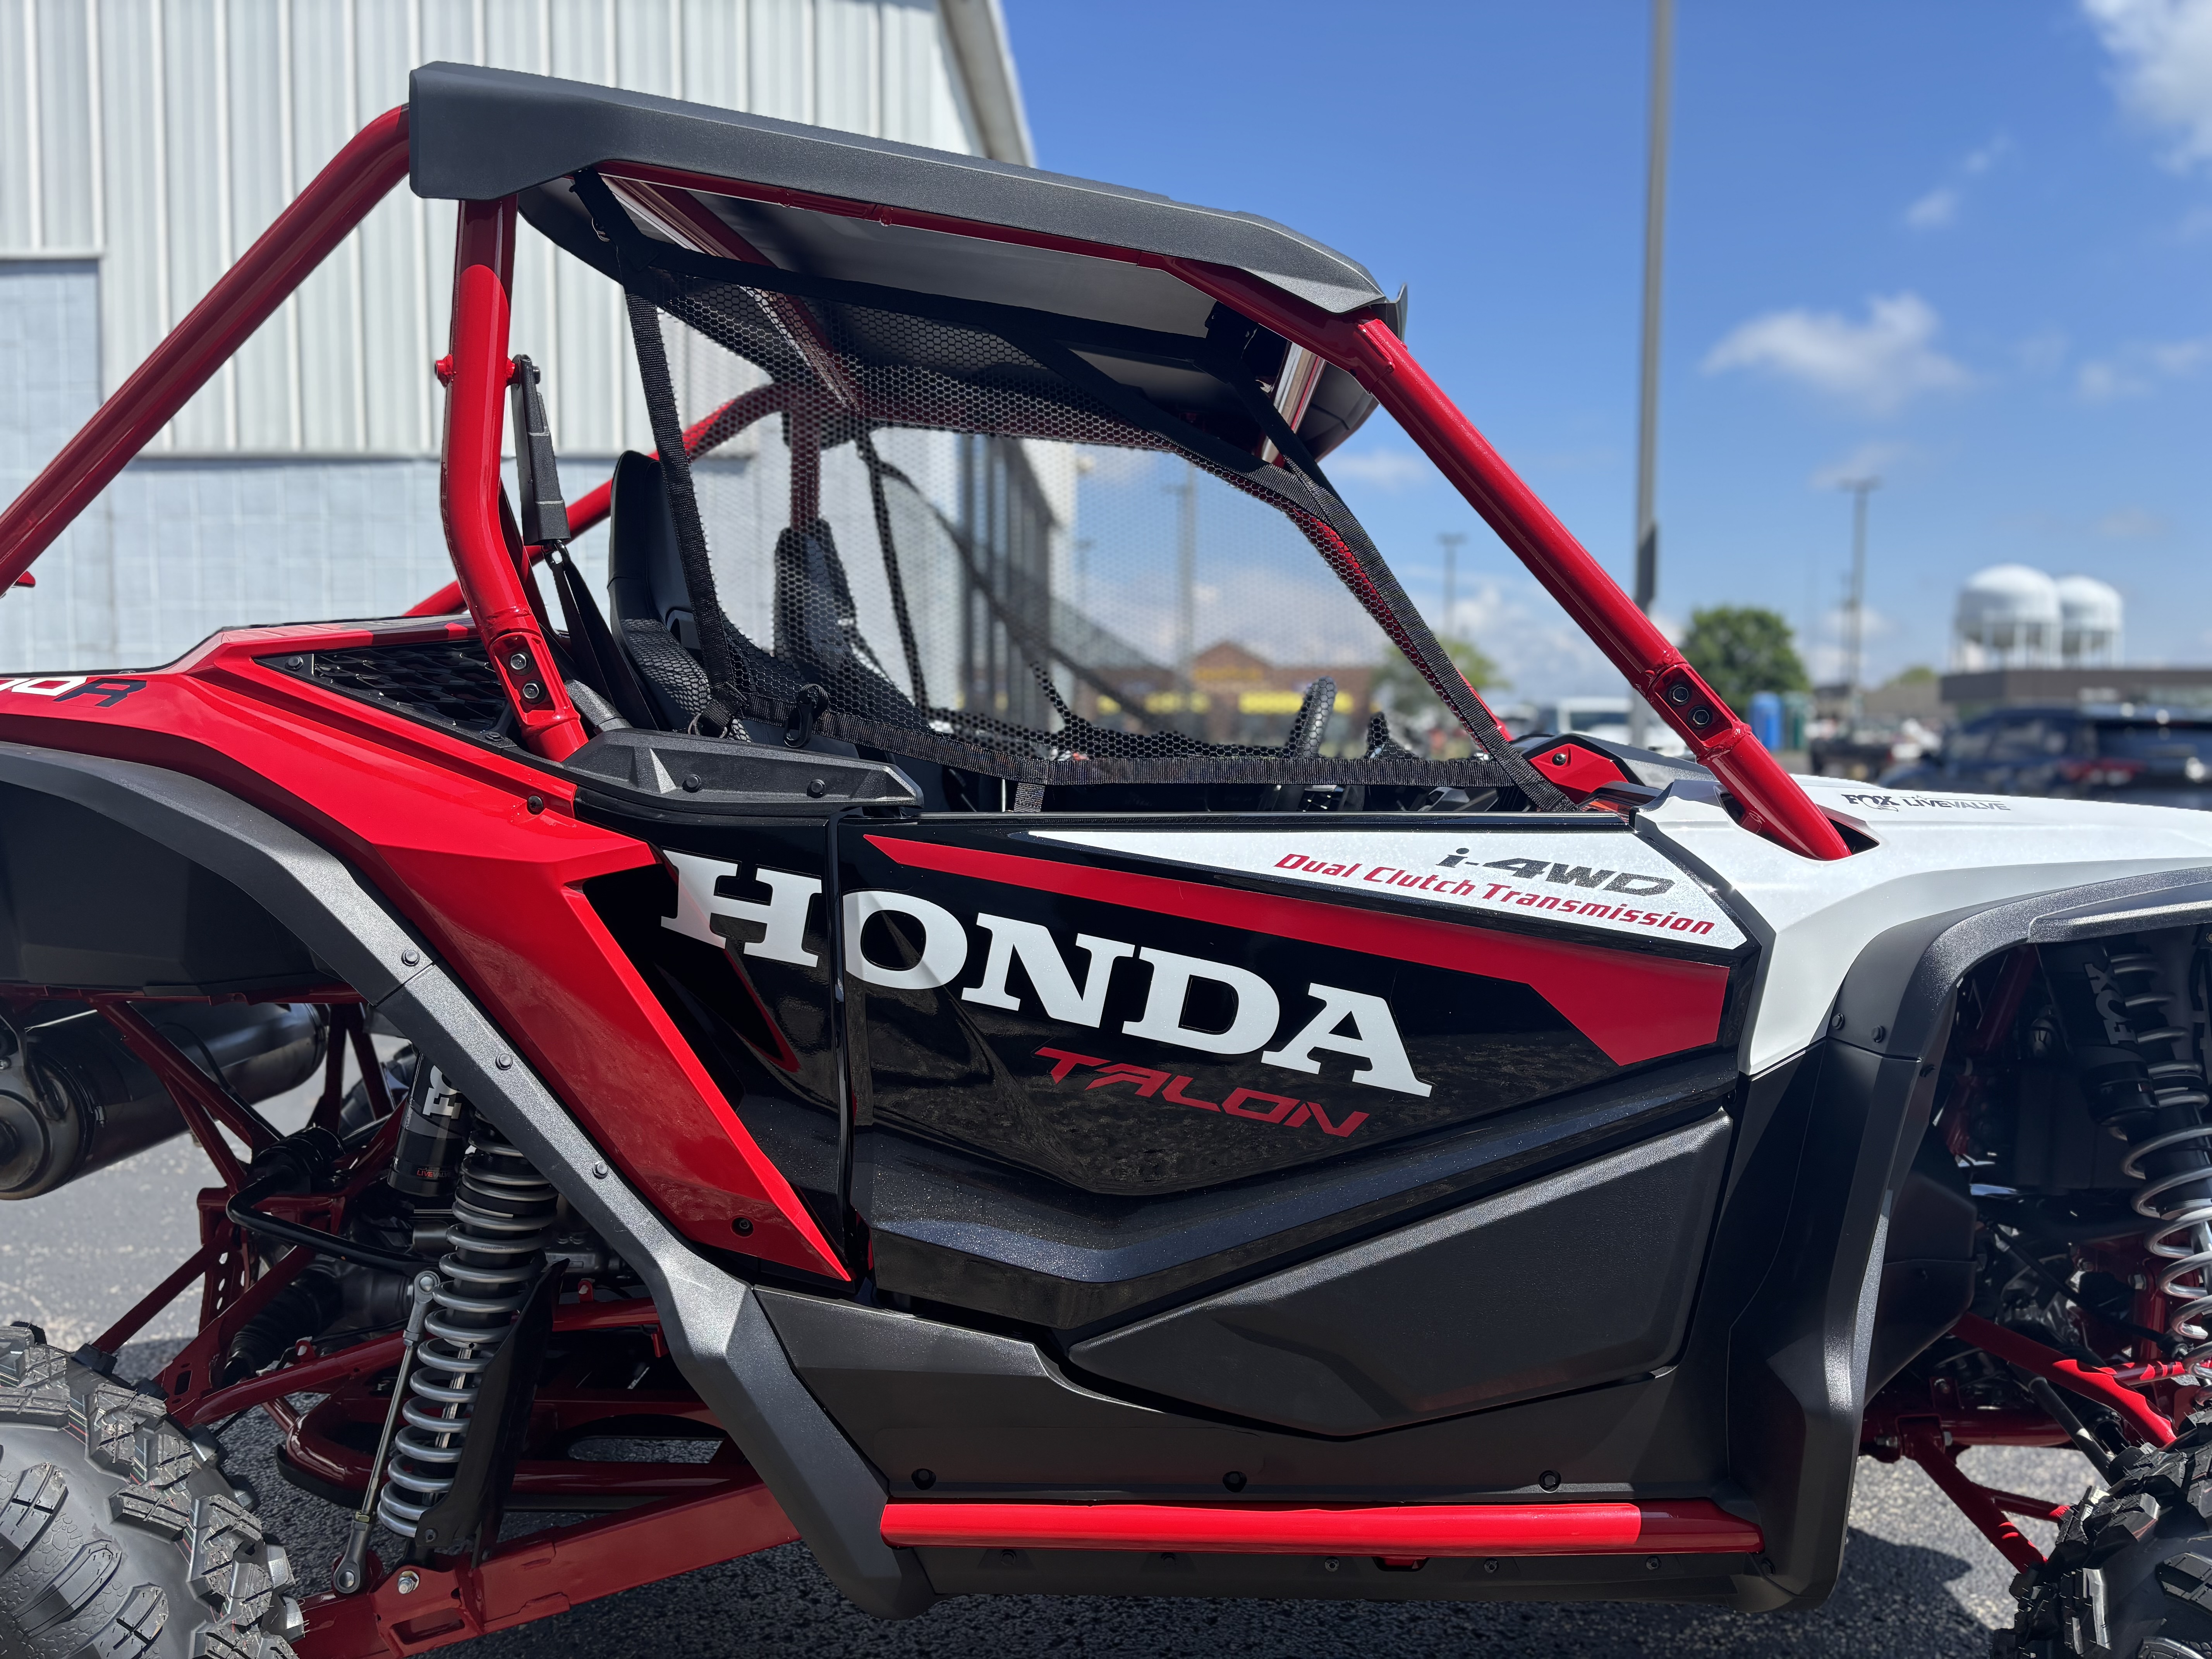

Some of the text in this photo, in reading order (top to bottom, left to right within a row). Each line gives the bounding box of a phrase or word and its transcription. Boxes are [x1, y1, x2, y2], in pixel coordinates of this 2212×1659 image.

[1841, 794, 2011, 811] FOX LIVEVALVE
[1274, 854, 1716, 935] Dual Clutch Transmission
[1436, 848, 1676, 896] i-4WD
[661, 848, 1432, 1097] HONDA
[2085, 963, 2138, 1044] FOX
[1035, 1047, 1370, 1137] TALON
